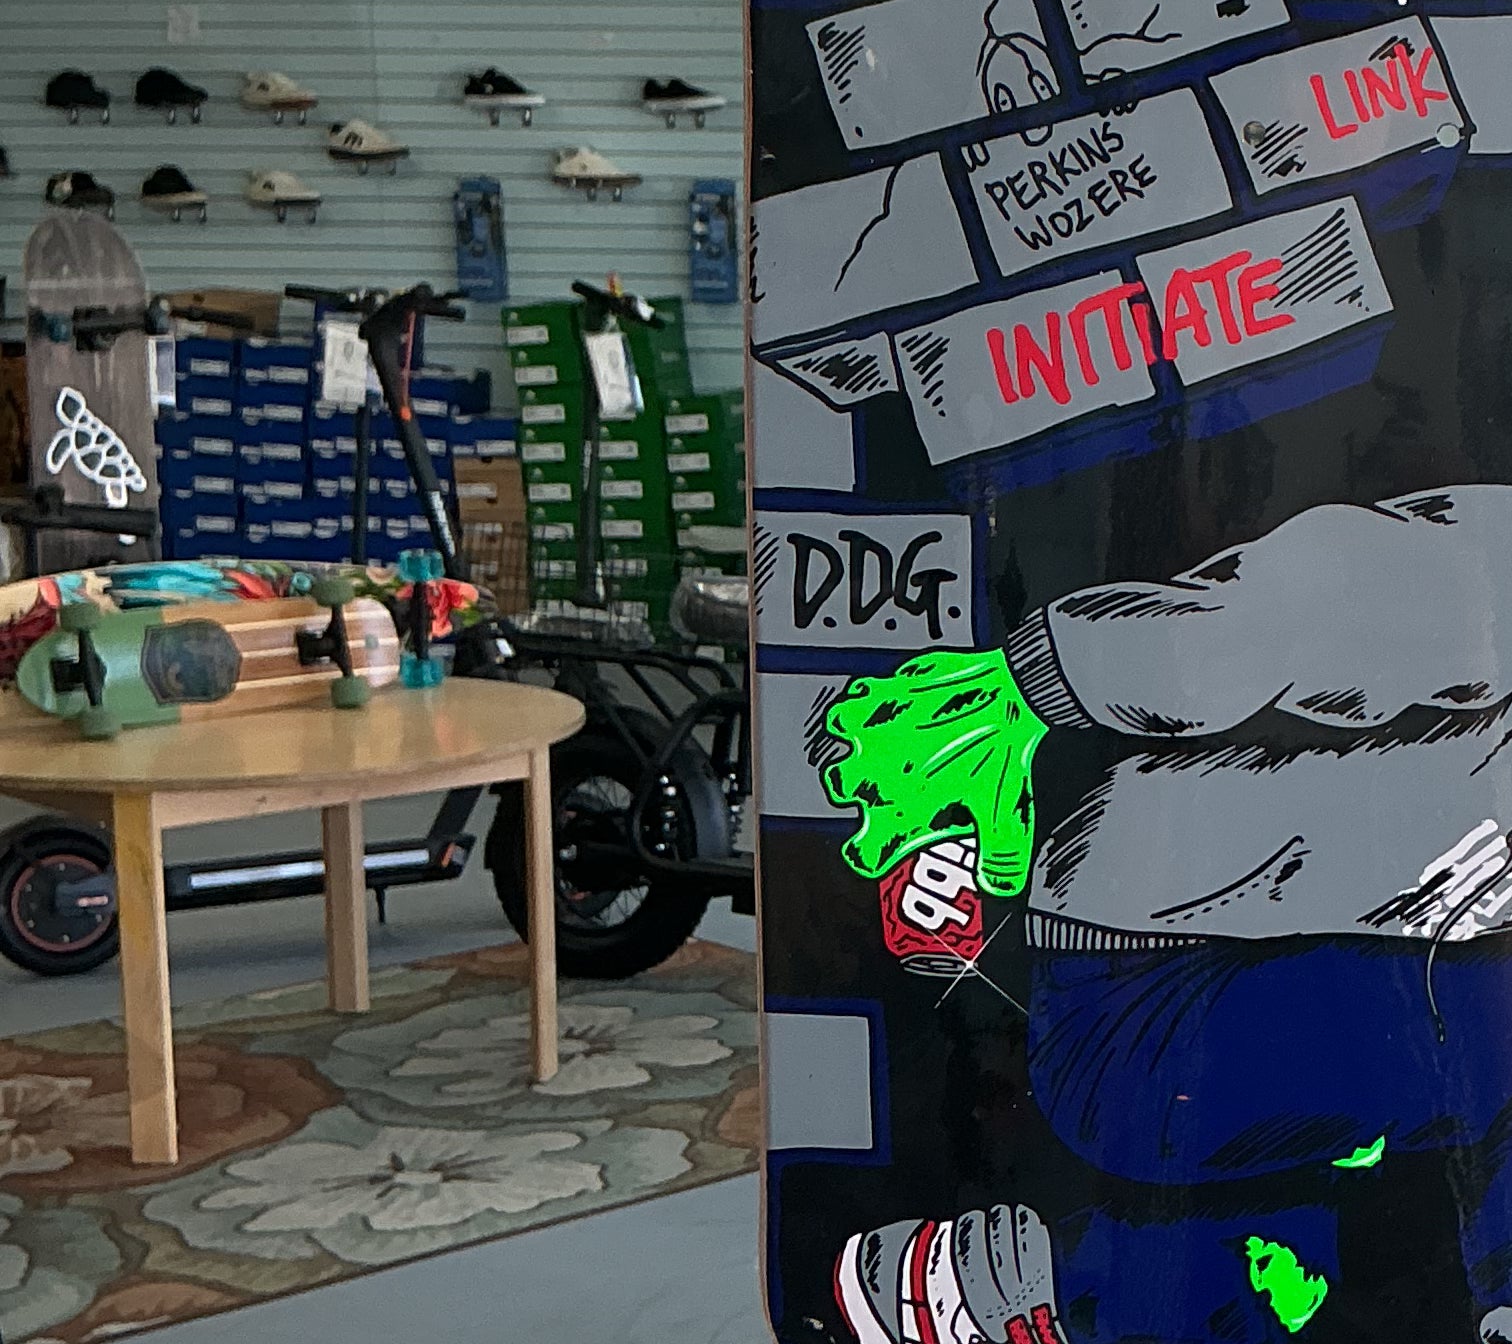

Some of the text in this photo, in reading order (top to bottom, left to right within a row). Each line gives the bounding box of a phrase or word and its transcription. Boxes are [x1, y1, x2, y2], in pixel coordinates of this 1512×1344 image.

[1310, 43, 1449, 141] LINK
[985, 122, 1125, 222] PERKINS
[1015, 153, 1157, 254] WOZERE
[986, 250, 1295, 406] INITIATE
[786, 529, 962, 640] D.D.G.
